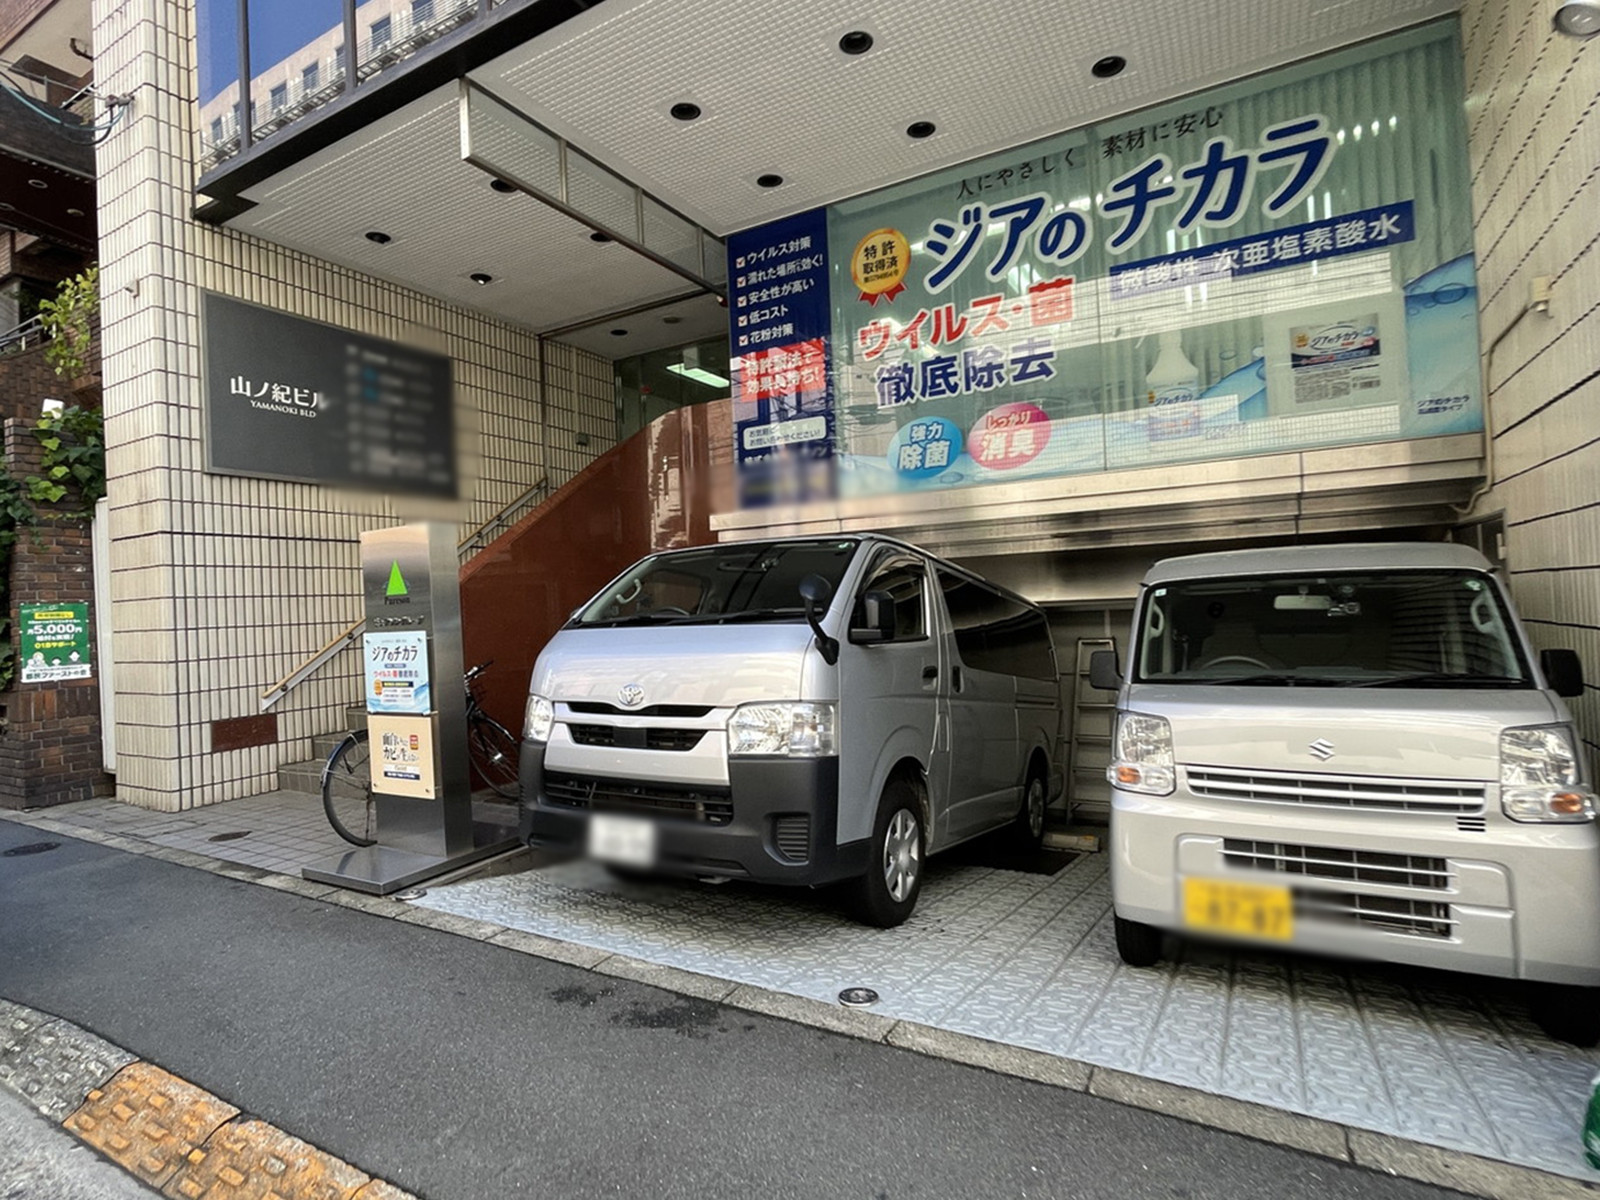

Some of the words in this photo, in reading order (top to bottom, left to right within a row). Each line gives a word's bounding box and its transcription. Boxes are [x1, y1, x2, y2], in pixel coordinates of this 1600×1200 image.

[956, 148, 1077, 200] 人にやさしく
[1102, 105, 1225, 159] 素材に安心
[926, 116, 1332, 290] ジアのチカラ
[747, 236, 811, 264] ウイルス対策
[864, 239, 896, 260] 特許
[1213, 212, 1402, 273] 次亜塩素酸水
[863, 255, 898, 275] 取得済
[748, 278, 814, 305] 安全性が高い
[749, 304, 789, 324] 低コスト
[860, 277, 1074, 359] ウイルス・菌
[750, 323, 793, 344] 花粉対策
[877, 338, 1055, 408] 徹底除去
[251, 400, 298, 415] YAMANOKI
[300, 409, 316, 418] BLD
[911, 422, 943, 442] 強力
[980, 428, 1036, 461] 消臭
[900, 441, 950, 470] 除菌
[372, 645, 418, 662] ジアのチカラ
